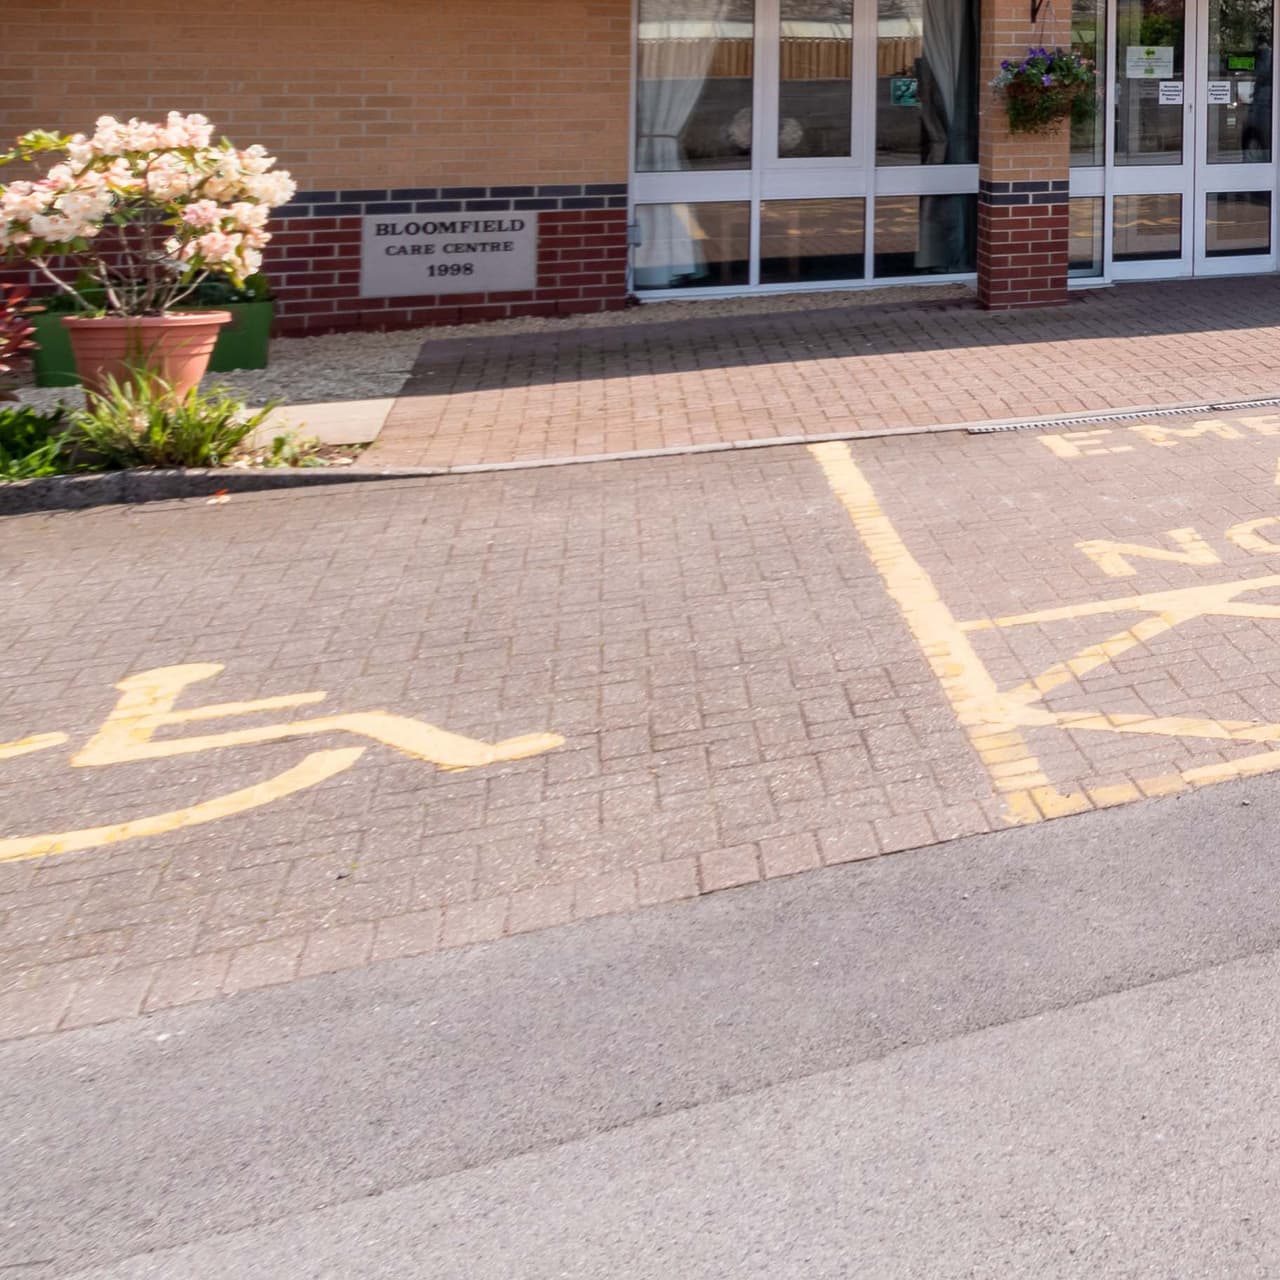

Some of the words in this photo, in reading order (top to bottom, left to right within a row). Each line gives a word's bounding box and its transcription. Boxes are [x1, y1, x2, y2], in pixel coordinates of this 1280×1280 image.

[375, 219, 526, 236] BLOOMFIELD
[384, 243, 436, 257] CARE
[443, 240, 515, 254] CENTRE
[426, 262, 475, 278] 1998
